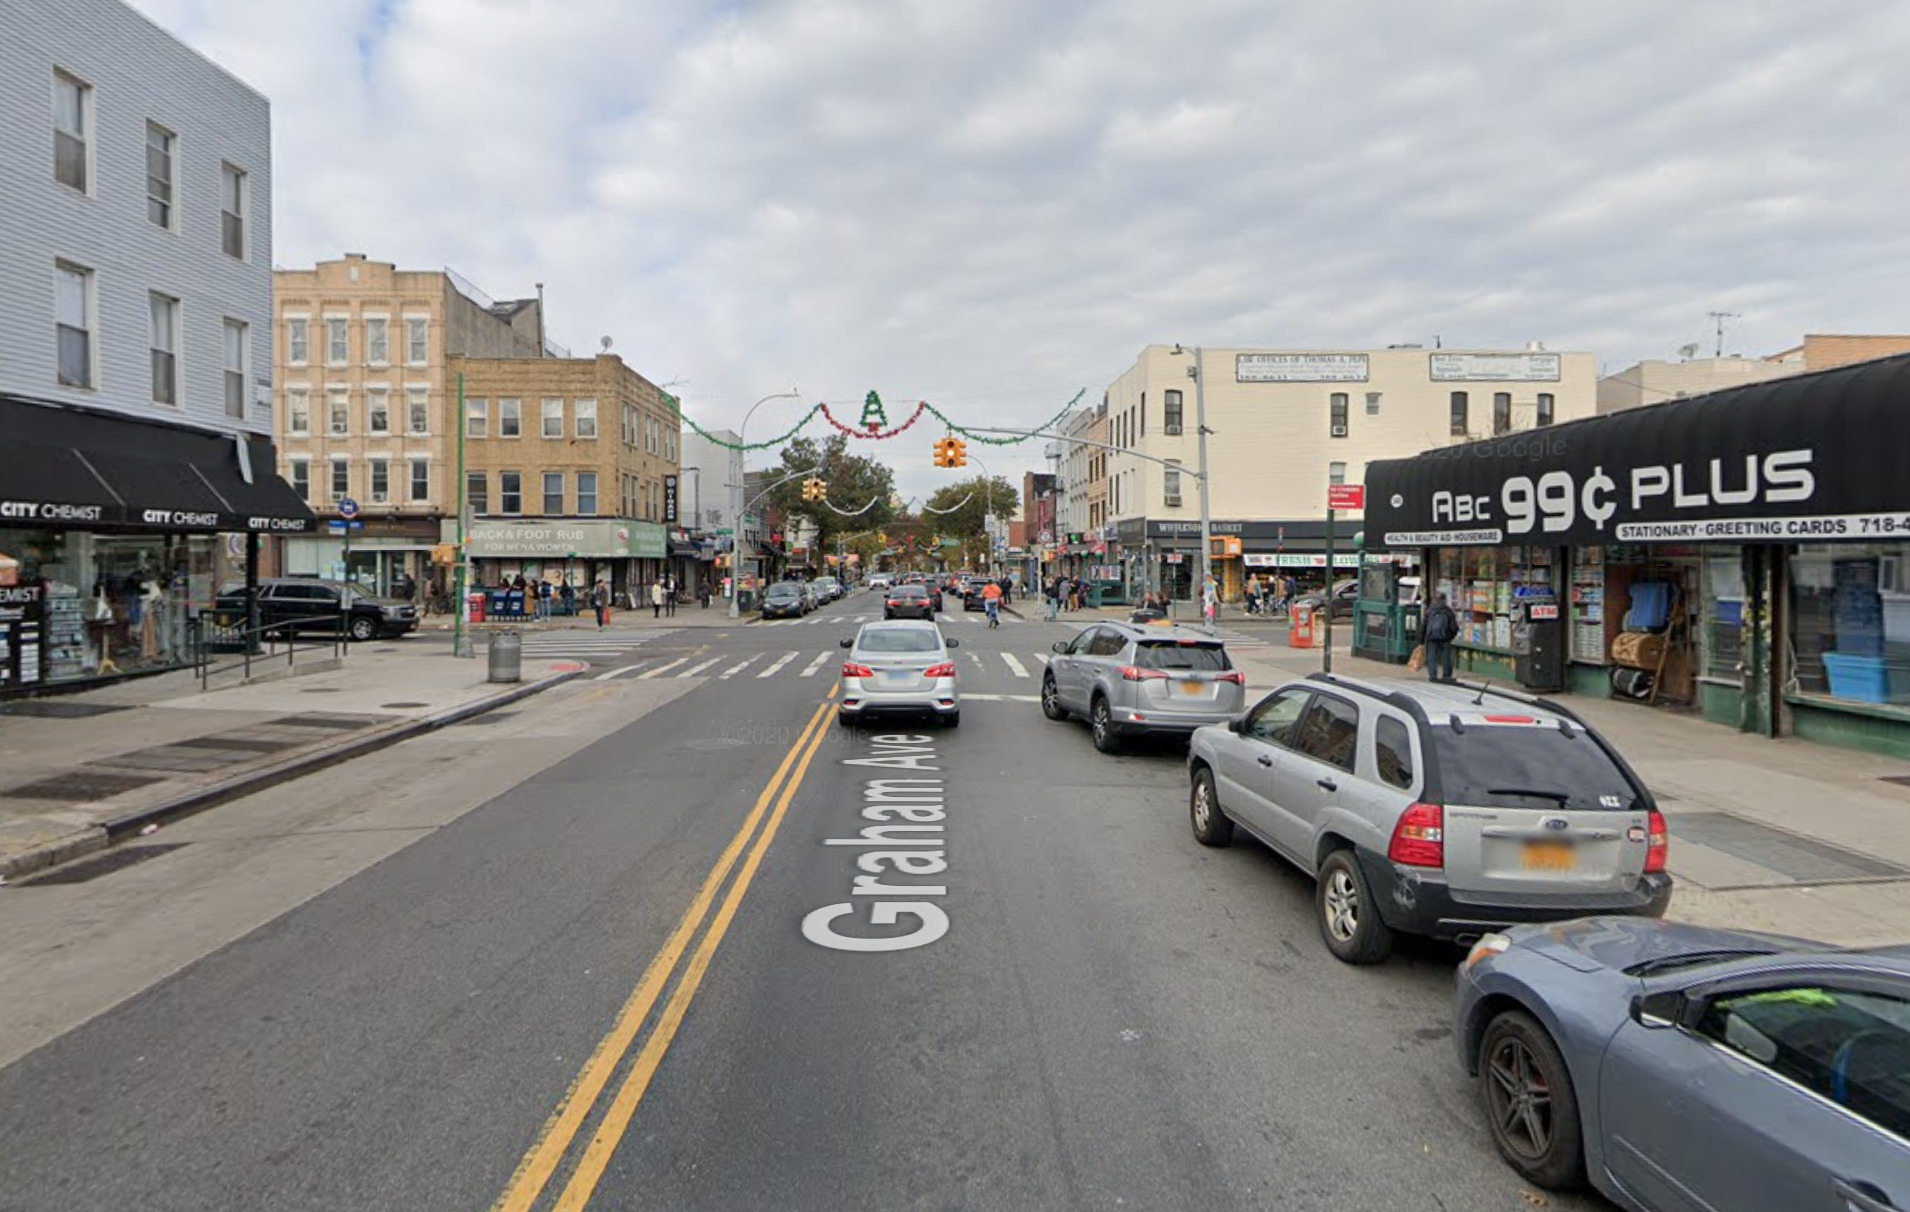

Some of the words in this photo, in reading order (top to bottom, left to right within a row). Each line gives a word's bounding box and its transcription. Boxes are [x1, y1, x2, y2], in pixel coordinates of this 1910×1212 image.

[1631, 449, 1815, 510] PLUS
[0, 502, 38, 517] CITY
[41, 504, 101, 520] CHEMIST
[143, 509, 171, 523] CITY
[173, 511, 218, 526] CHEMIST
[249, 517, 270, 529] CITY
[271, 518, 305, 531] CHEMIST
[1706, 521, 1782, 535] GREETING
[1786, 519, 1847, 534] CARDS
[517, 530, 552, 539] FOOT
[557, 530, 584, 540] RUB
[1532, 607, 1556, 616] ATM
